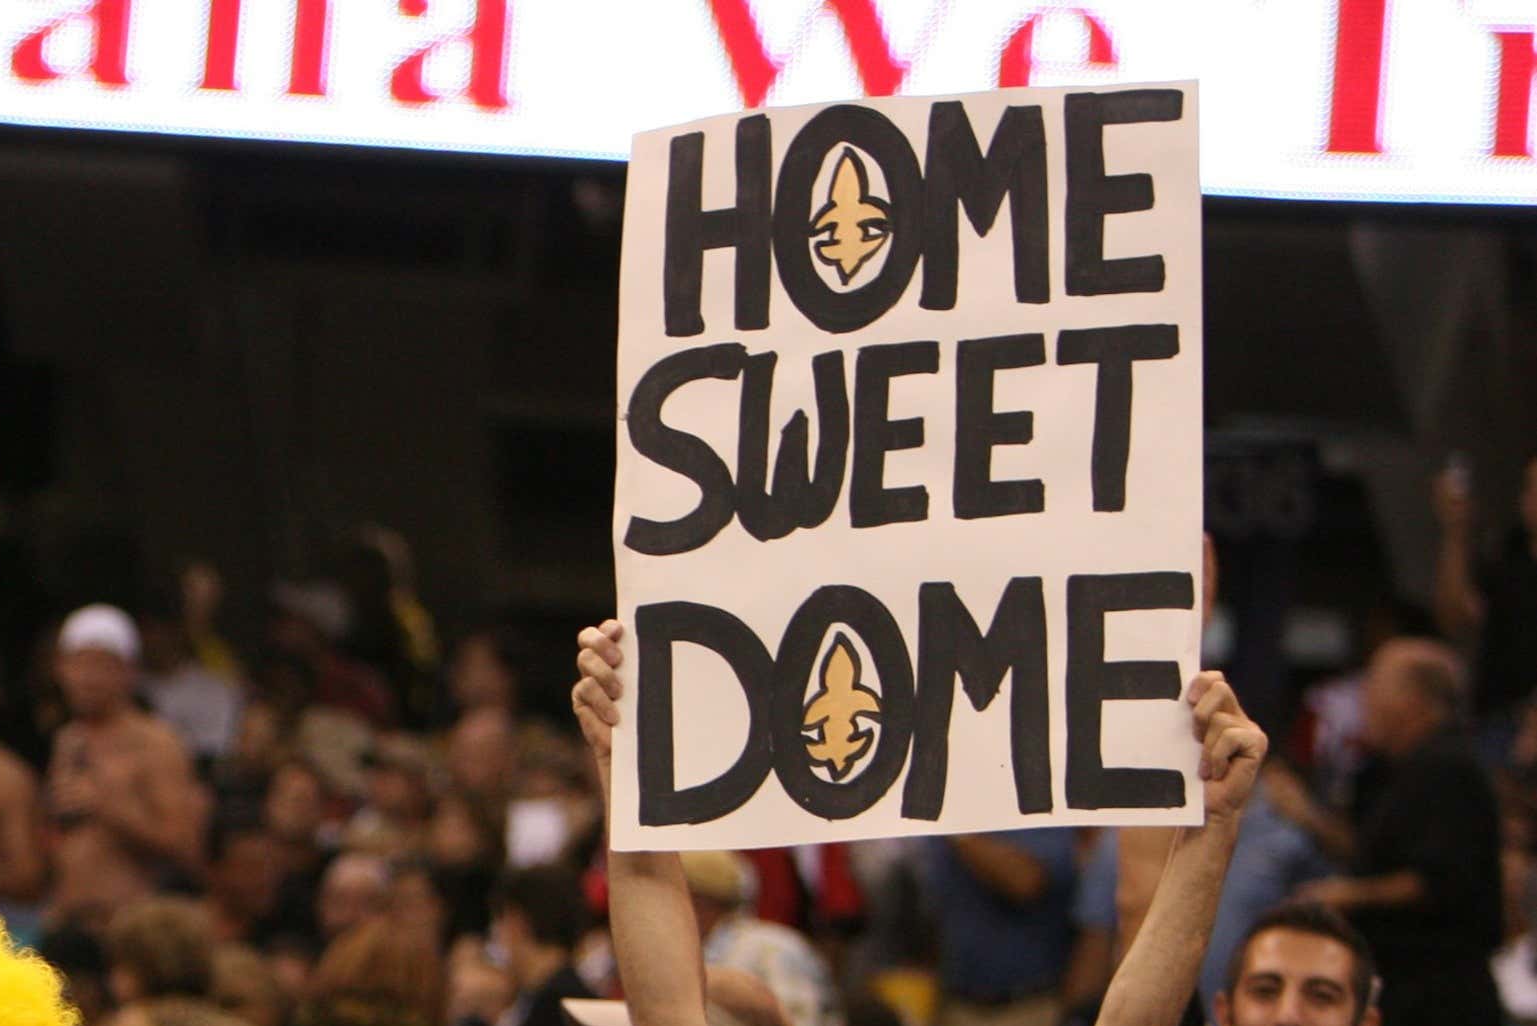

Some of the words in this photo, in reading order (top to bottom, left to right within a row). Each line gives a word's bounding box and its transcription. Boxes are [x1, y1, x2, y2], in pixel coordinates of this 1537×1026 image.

[664, 88, 1184, 336] HOME
[623, 323, 1179, 556] SWEET
[635, 571, 1193, 826] DOME
